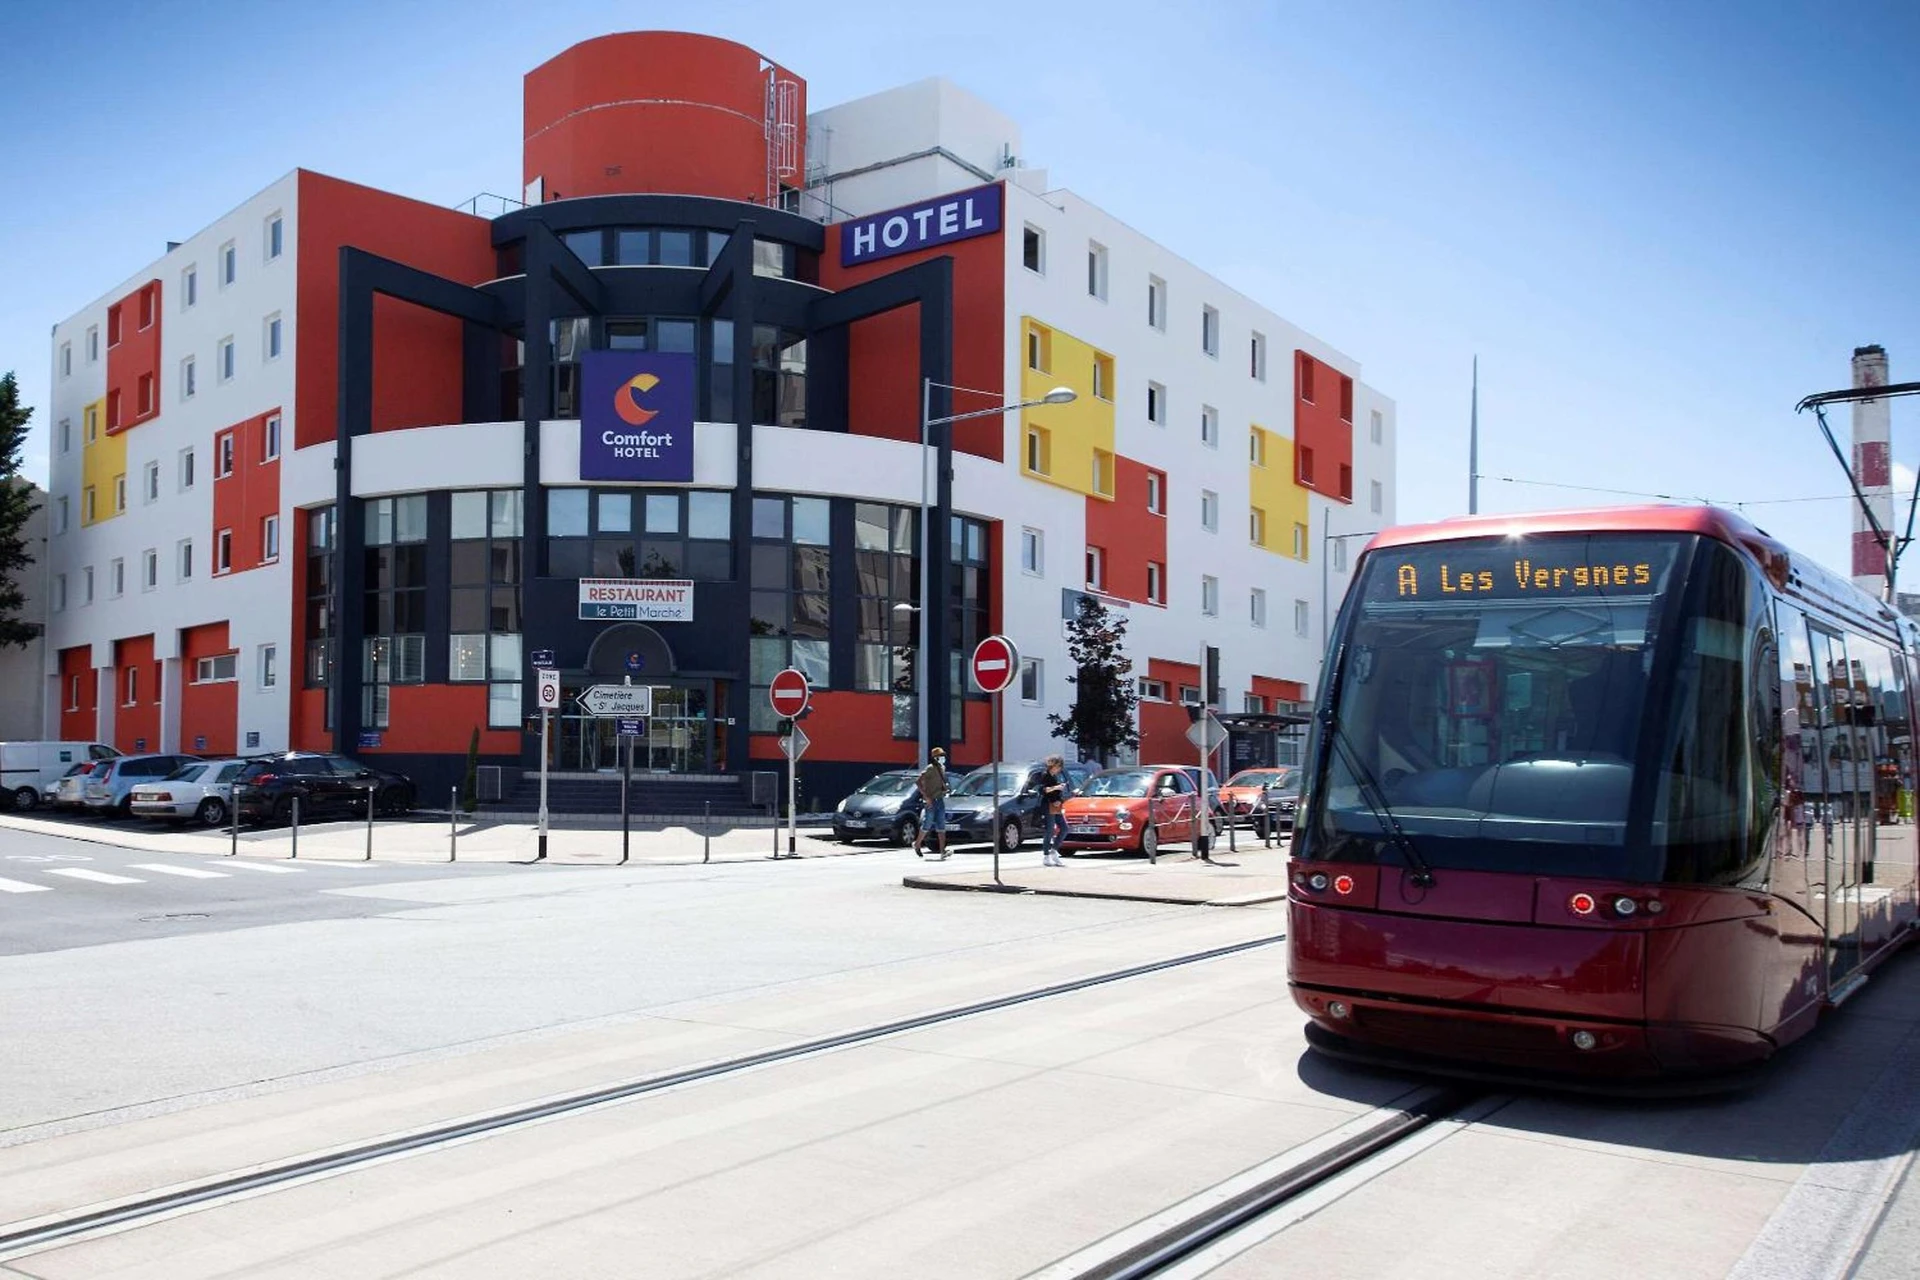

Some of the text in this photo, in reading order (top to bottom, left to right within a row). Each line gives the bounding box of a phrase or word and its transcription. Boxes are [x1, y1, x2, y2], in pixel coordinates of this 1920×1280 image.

[853, 198, 983, 257] HOTEL
[602, 430, 673, 446] Comfort
[614, 447, 660, 458] HOTEL
[1398, 559, 1650, 596] A Les Vergnes
[589, 587, 686, 602] RESTAURANT
[597, 605, 607, 618] le
[610, 605, 636, 618] Petit
[541, 672, 557, 681] ZONE
[611, 701, 645, 712] Jacques
